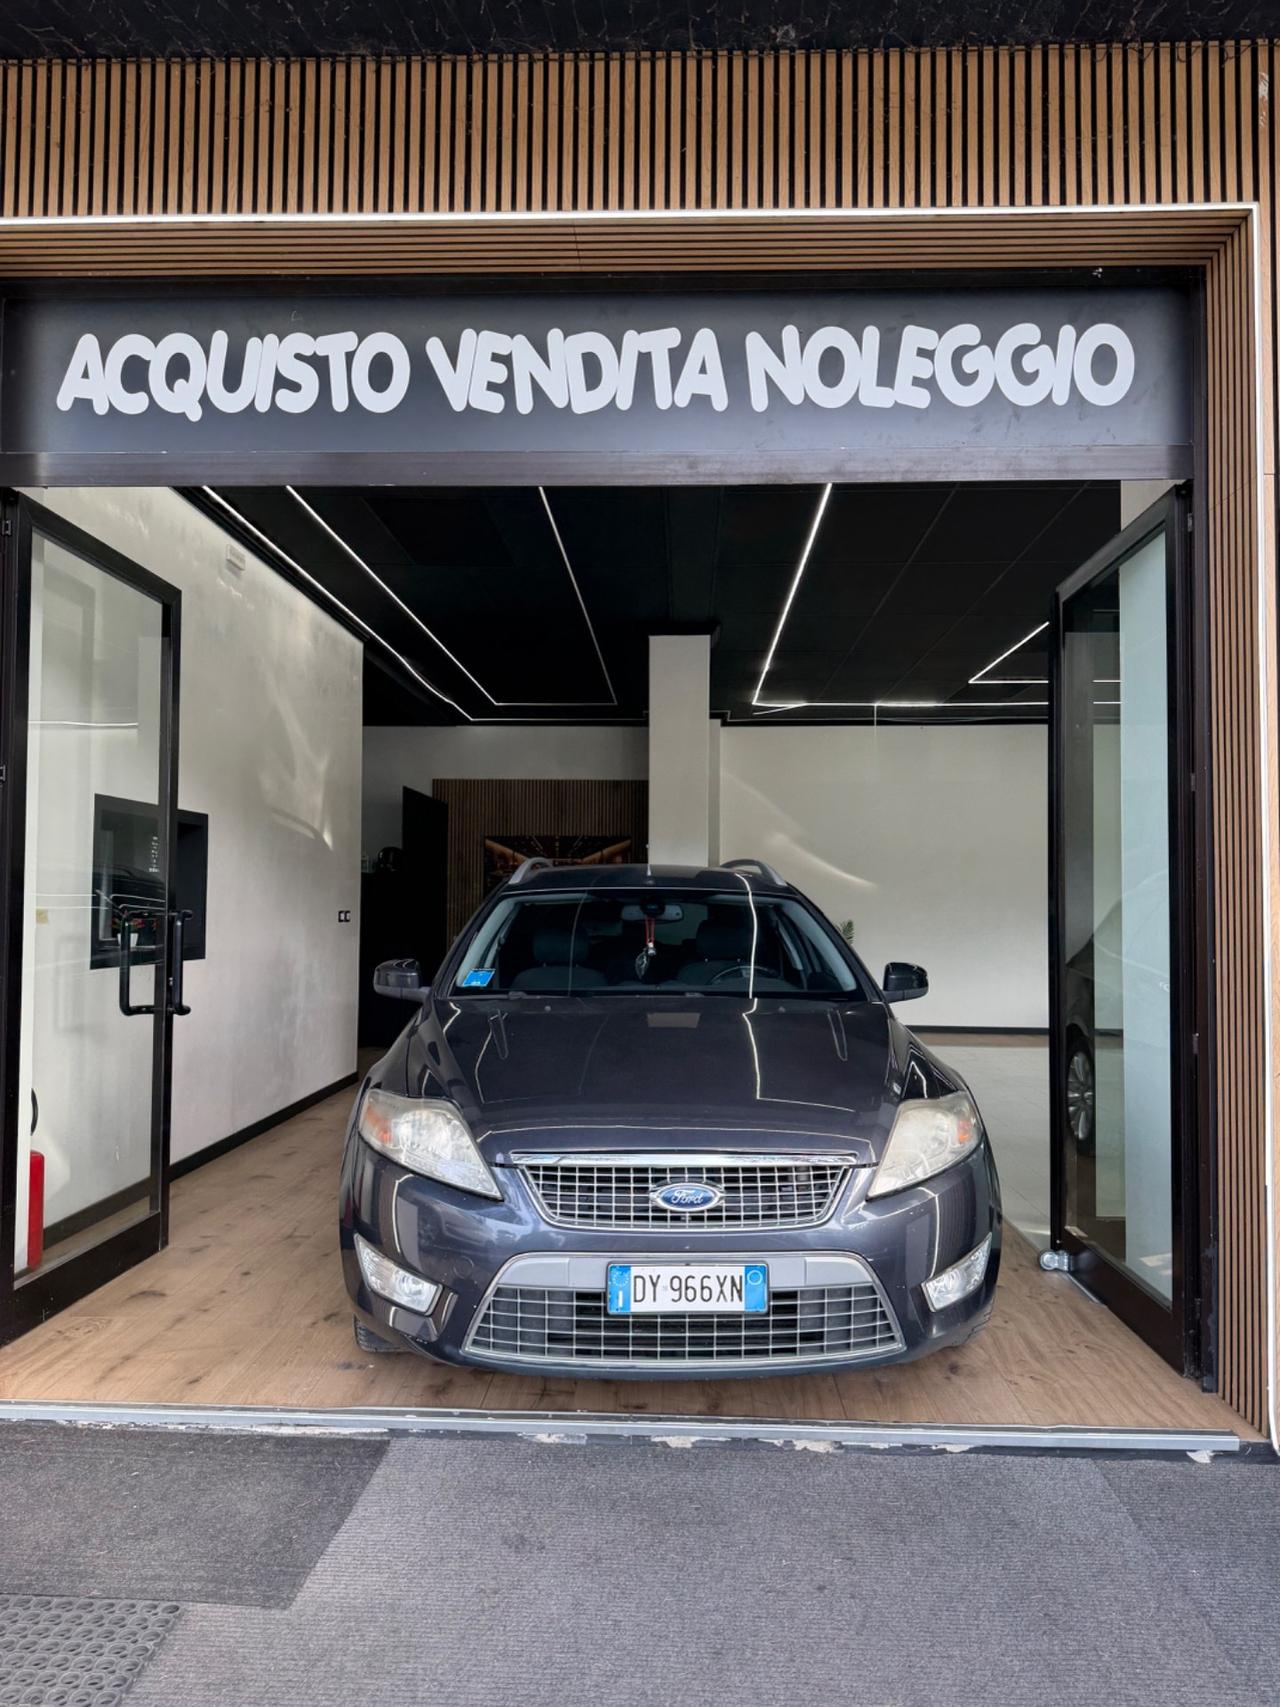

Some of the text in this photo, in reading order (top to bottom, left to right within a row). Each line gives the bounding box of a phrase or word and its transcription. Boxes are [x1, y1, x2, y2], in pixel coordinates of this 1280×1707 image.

[56, 322, 1135, 423] ACQUISTO VENDITA NOLEGGIO
[671, 1189, 705, 1204] Ford
[633, 1274, 743, 1303] DY 966XN
